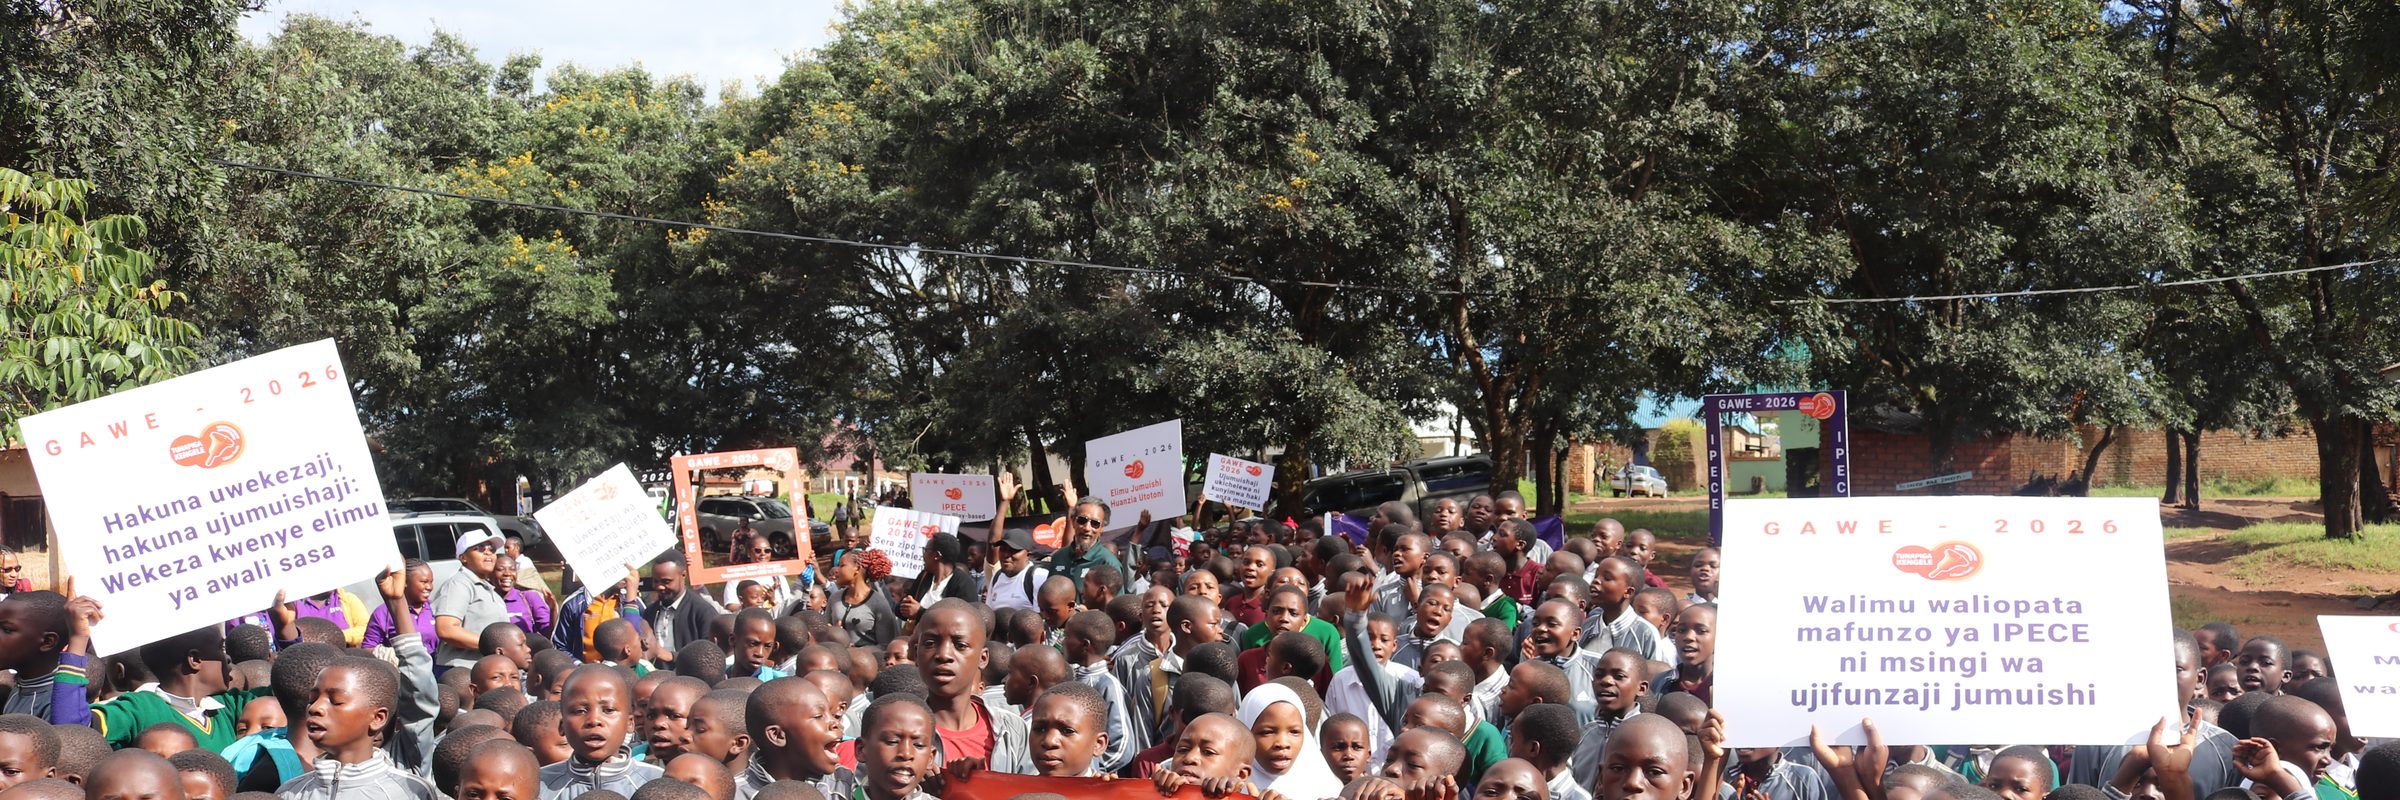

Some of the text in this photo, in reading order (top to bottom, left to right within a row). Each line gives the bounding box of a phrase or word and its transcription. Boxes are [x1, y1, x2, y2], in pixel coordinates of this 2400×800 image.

[45, 413, 160, 456] GAWE
[240, 365, 338, 404] 2026
[1719, 399, 1752, 409] GAWE
[1765, 397, 1796, 408] 2026
[688, 456, 720, 468] GAWE
[731, 454, 759, 465] 2026
[1096, 455, 1124, 467] GAWE
[1145, 444, 1172, 456] 2026
[1220, 457, 1244, 467] GAWE
[1836, 431, 1846, 493] IPEC
[641, 472, 672, 482] 2026
[1220, 465, 1241, 475] 2026
[1709, 434, 1719, 509] IPECE
[1110, 479, 1161, 497] Elimu Jumuishi
[1215, 480, 1252, 492] ukichelewa
[1219, 473, 1259, 487] Ujumuishaji
[102, 452, 343, 534] Hakuna uwekezaji,
[1111, 490, 1164, 507] Huanzia Utotoni
[1211, 485, 1245, 497] kunyimwa
[793, 479, 808, 543] IPECE
[942, 503, 967, 511] IPECE
[102, 478, 360, 564] hakuna ujumuishaji:
[681, 488, 697, 553] IPECE
[888, 517, 918, 529] GAWE
[1764, 520, 1893, 535] GAWE
[1994, 519, 2118, 534] 2026
[888, 528, 914, 539] 2026
[101, 502, 380, 594] Wekeza kwenye elimu
[874, 536, 916, 550] Sera zipo
[902, 561, 924, 570] viten
[168, 544, 335, 610] ya awali sasa
[1803, 595, 2083, 618] Walimu waliopata
[1797, 621, 2089, 647] mafunzo ya IPECE
[1840, 651, 2043, 678] ni msingi wa
[1791, 682, 2095, 712] ujifunzaji jumuishi
